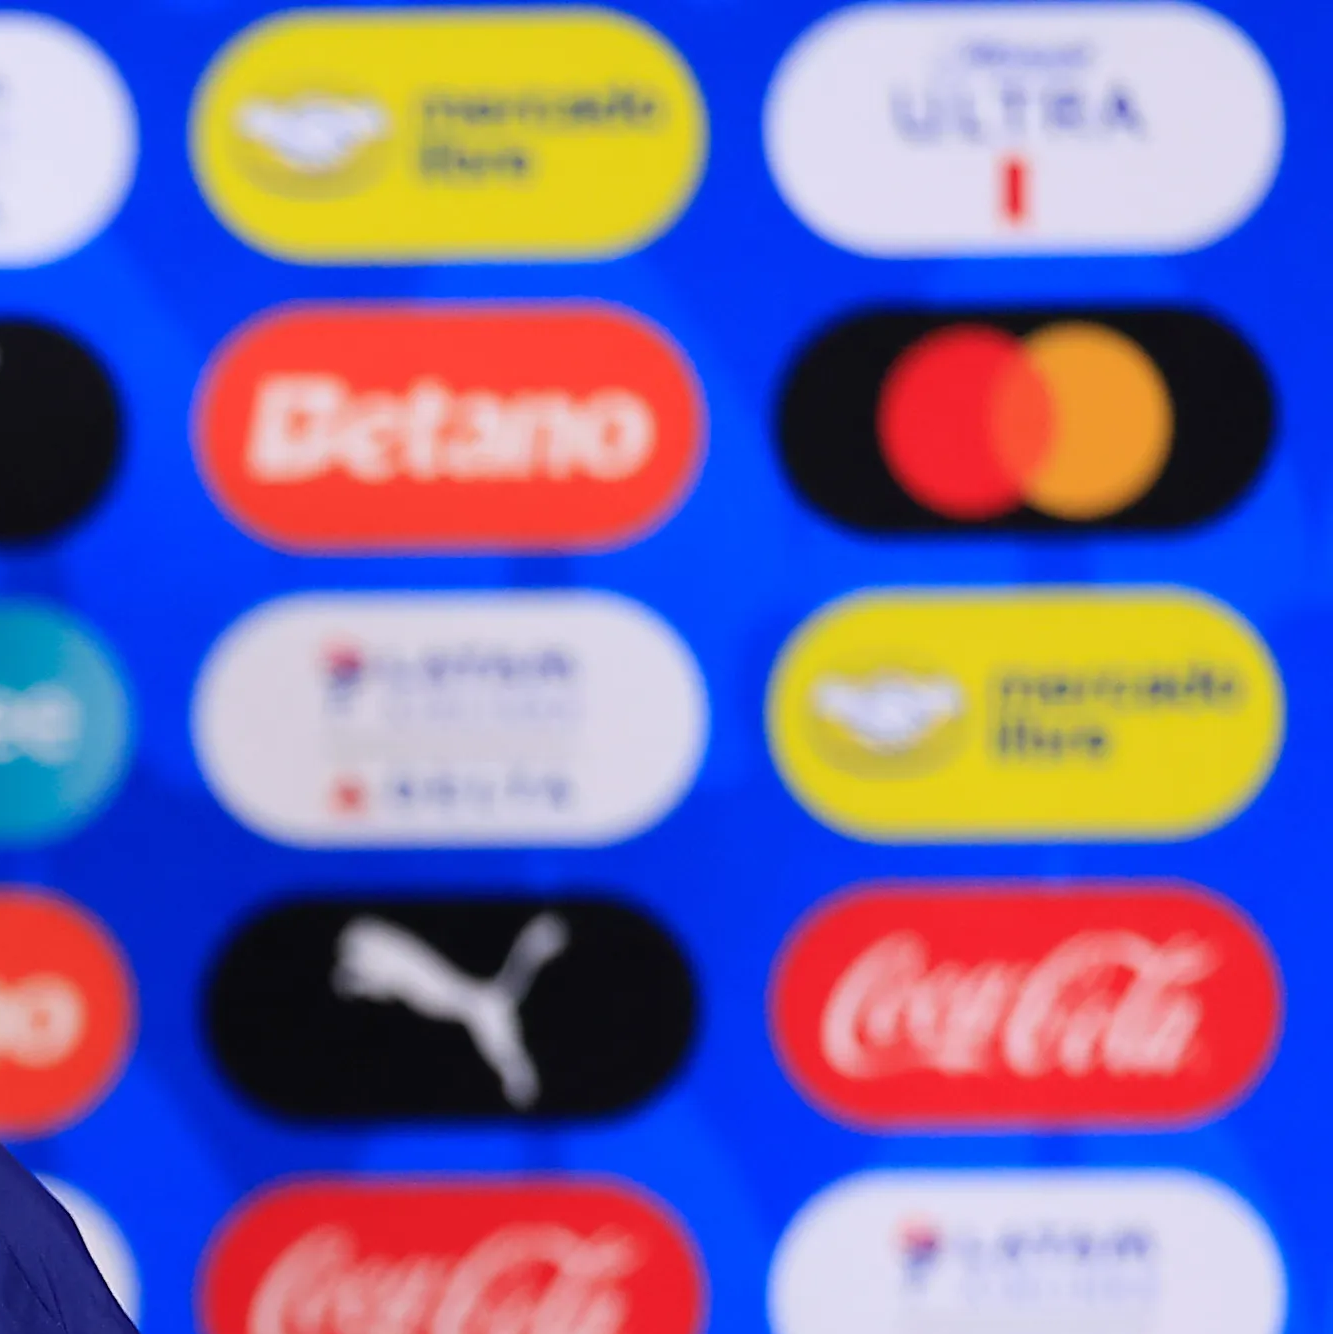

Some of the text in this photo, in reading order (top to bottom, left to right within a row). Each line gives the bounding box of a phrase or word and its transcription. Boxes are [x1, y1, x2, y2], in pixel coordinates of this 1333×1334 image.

[419, 86, 663, 132] mercado
[893, 82, 1144, 139] ULTRA
[416, 137, 532, 180] libre
[245, 374, 655, 481] Betano
[993, 658, 1247, 708] mercado
[990, 708, 1112, 762] libre
